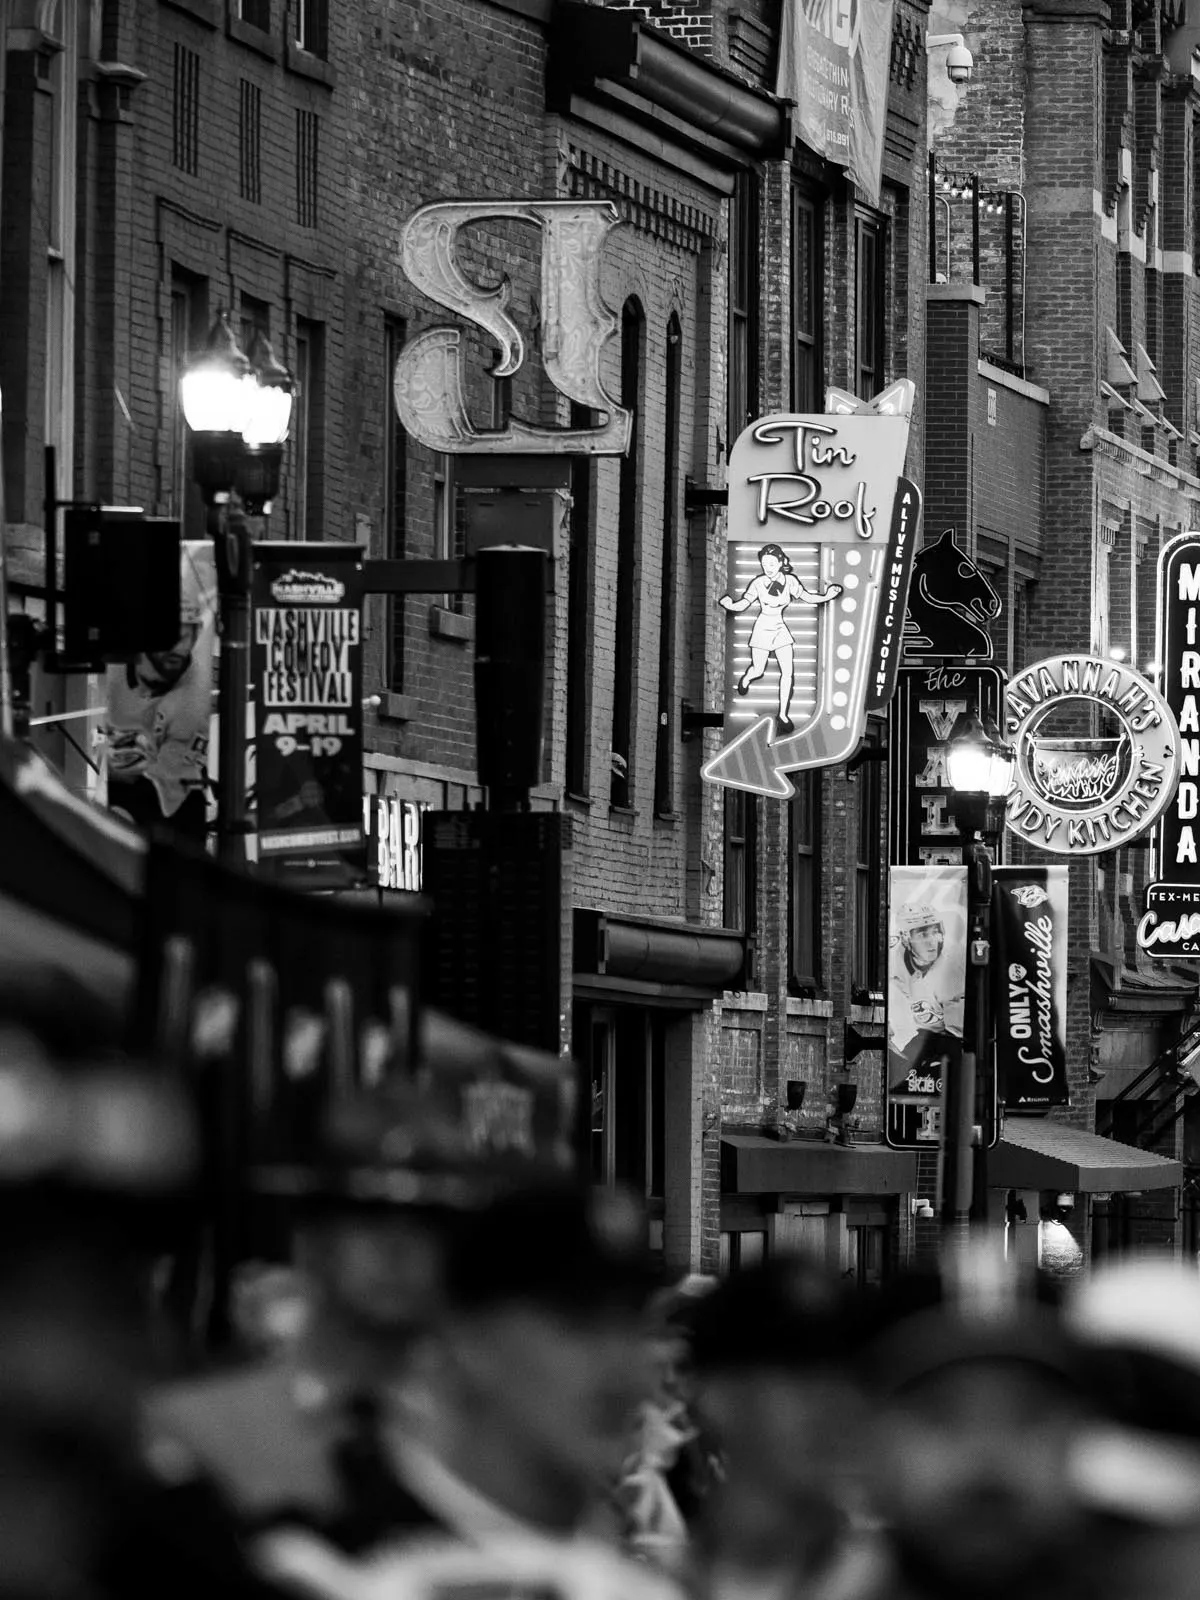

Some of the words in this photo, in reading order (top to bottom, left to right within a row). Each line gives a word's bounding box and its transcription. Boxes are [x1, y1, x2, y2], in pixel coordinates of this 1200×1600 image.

[753, 421, 856, 472] Tin
[747, 473, 878, 539] Roof
[896, 508, 907, 558] LIVE
[885, 563, 902, 627] MUSIC
[257, 610, 359, 643] NASHVILLE
[270, 642, 347, 671] COMEDY
[876, 634, 892, 697] JOINT
[266, 671, 351, 705] FESTIVAL
[1006, 660, 1161, 733] SAVANNAH'S
[263, 714, 354, 735] APRIL
[1005, 782, 1062, 842] NDY
[1068, 760, 1165, 848] KITCHEN
[378, 799, 424, 893] BAR
[1009, 984, 1031, 1038] ONLY
[1018, 915, 1054, 1083] Smashville
